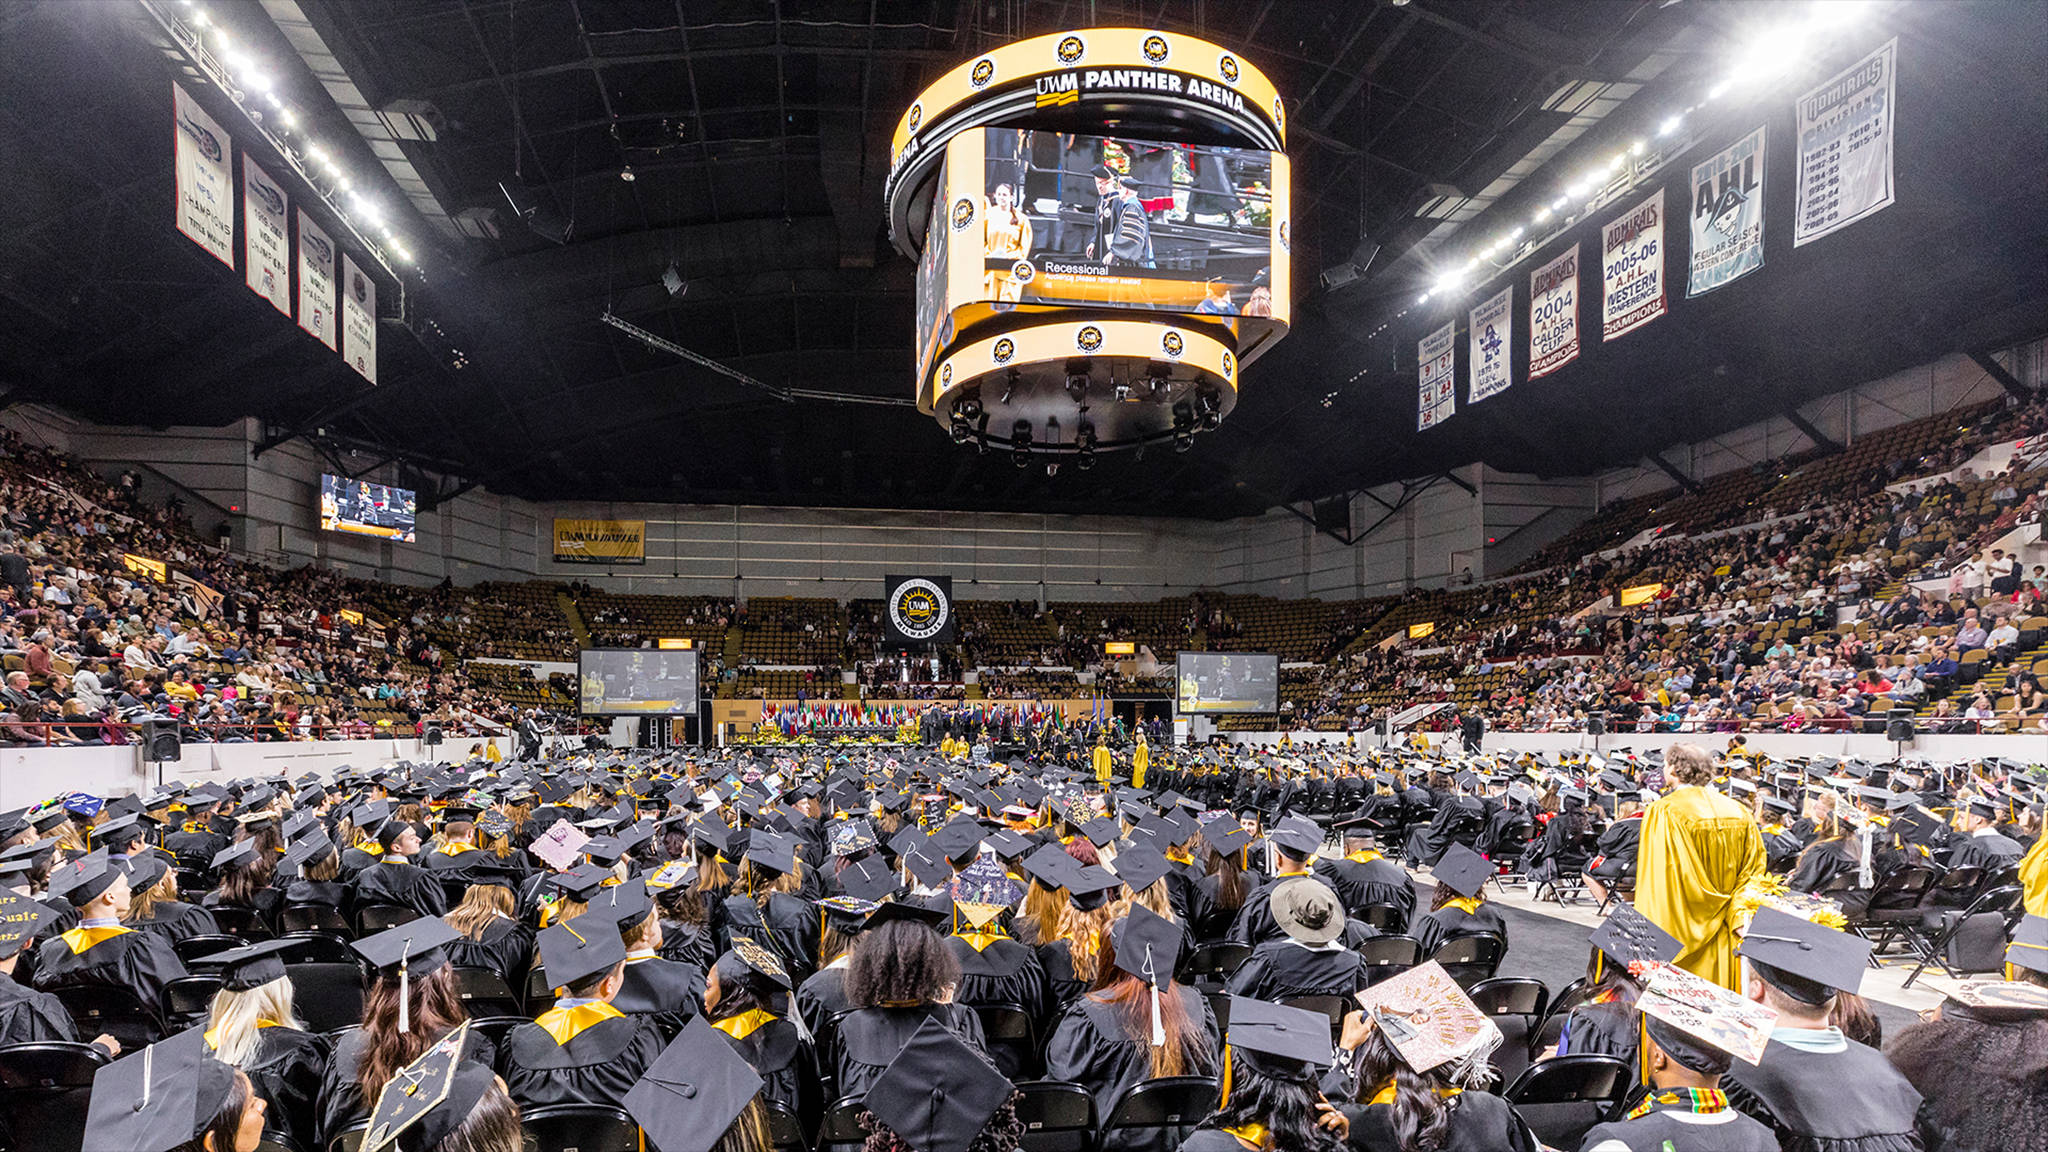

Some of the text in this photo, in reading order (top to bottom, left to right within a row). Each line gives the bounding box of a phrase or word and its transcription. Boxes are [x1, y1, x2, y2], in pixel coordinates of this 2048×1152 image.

[1036, 70, 1245, 112] UWM PANTHER ARENA
[1816, 94, 1872, 131] DIVISION
[1696, 155, 1759, 219] AHL
[1607, 204, 1658, 254] ADMIRALS
[1045, 262, 1109, 275] Recessional
[1606, 240, 1657, 280] 2005-06
[1608, 270, 1657, 307] WESTERN
[1608, 285, 1657, 316] CONFERENCE
[1535, 290, 1573, 324] 2004
[1603, 299, 1662, 334] CHAMPIONS
[1533, 318, 1574, 346] CALDER
[1541, 335, 1564, 354] CUP
[1530, 341, 1578, 371] CHAMPIONS
[908, 601, 930, 610] UWM
[896, 620, 942, 637] MILWAUKEE
